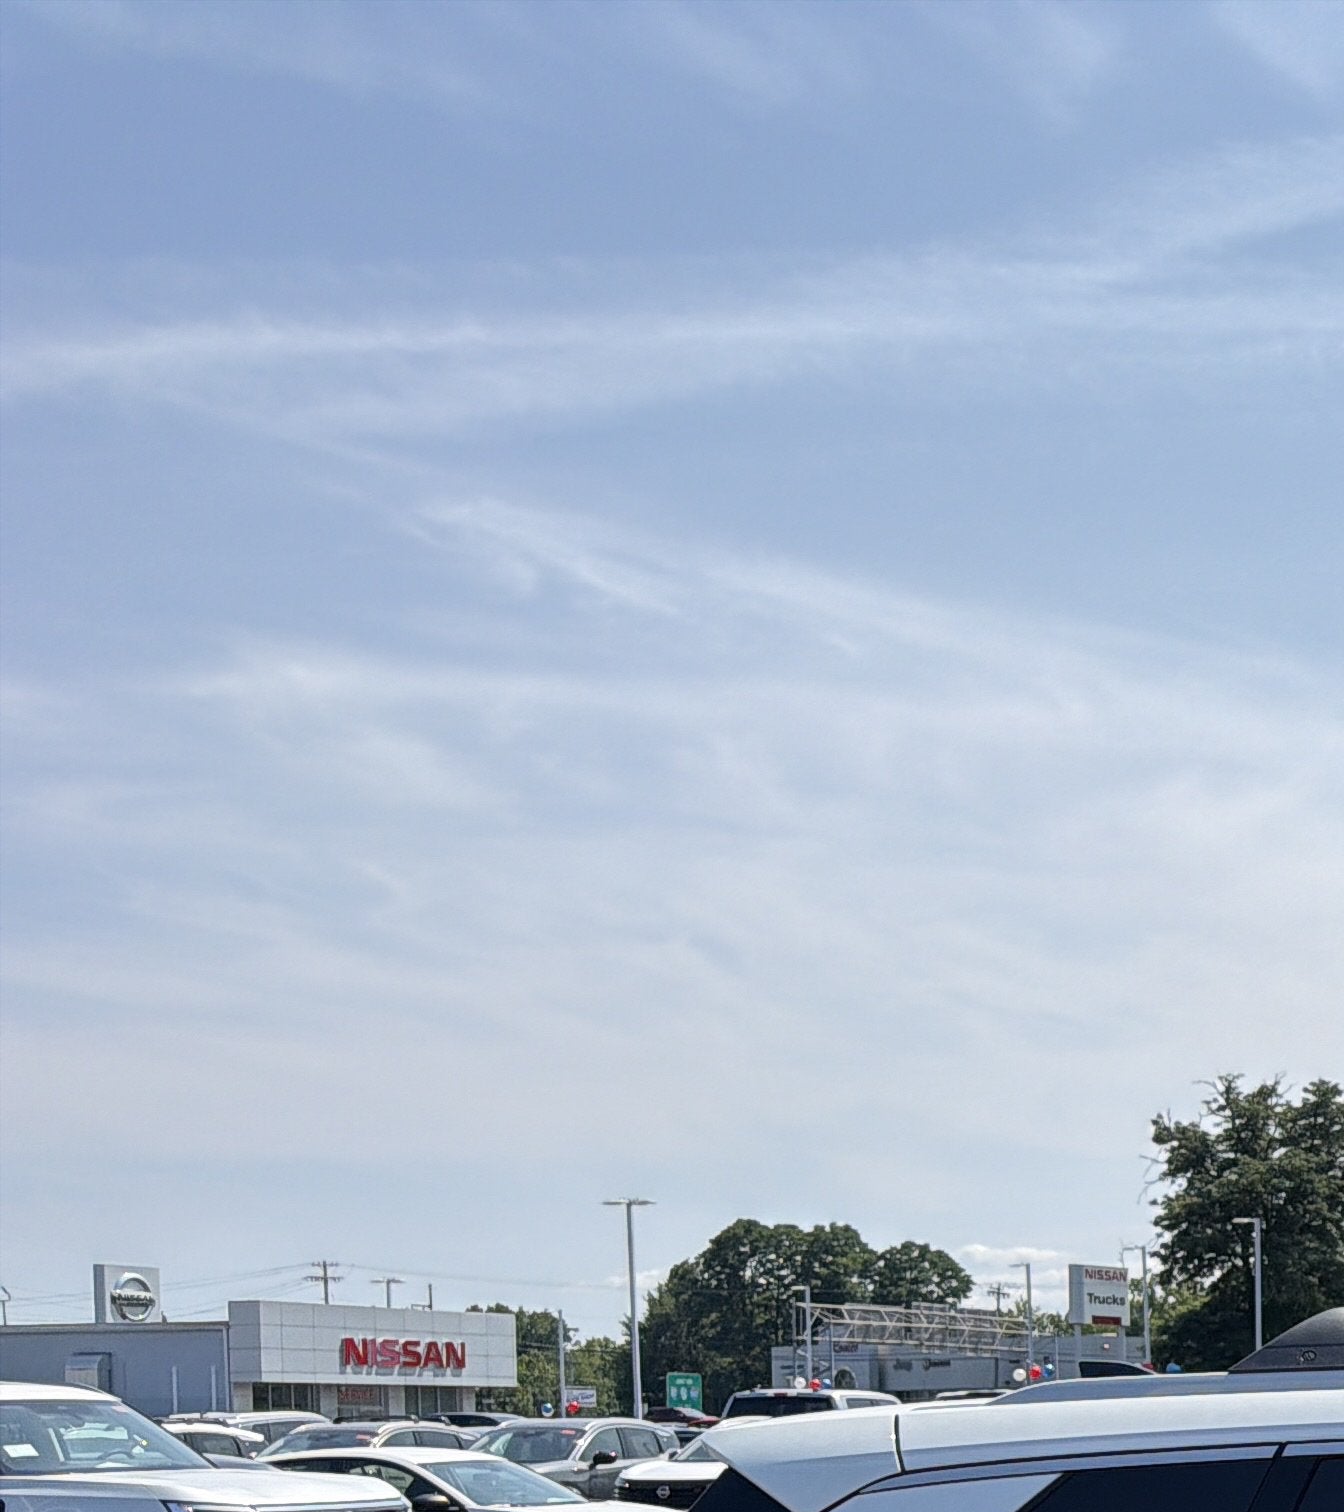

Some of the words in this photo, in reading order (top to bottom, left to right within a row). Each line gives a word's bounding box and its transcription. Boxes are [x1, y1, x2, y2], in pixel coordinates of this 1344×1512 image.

[1084, 1268, 1128, 1282] NISSAN
[1086, 1292, 1126, 1306] Trucks
[343, 1336, 466, 1370] NISSAN
